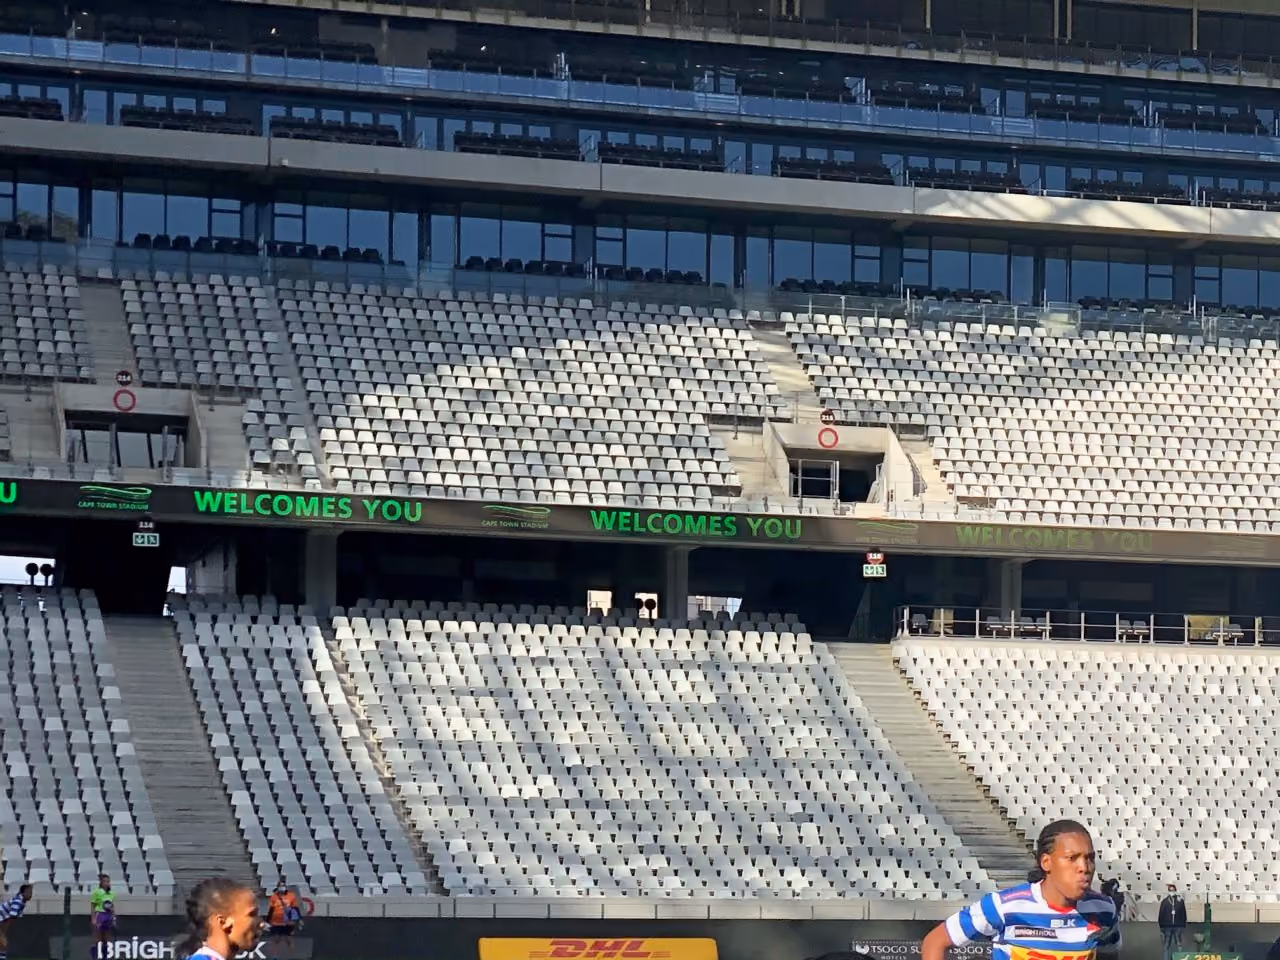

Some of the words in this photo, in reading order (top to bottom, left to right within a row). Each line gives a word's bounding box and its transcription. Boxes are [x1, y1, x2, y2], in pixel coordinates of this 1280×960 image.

[194, 490, 352, 519] WELCOMES
[362, 499, 422, 523] YOU
[589, 509, 737, 537] WELCOMES
[747, 517, 803, 539] YOU
[955, 525, 1095, 551] WELCOMES
[1102, 532, 1154, 553] YOU
[1050, 919, 1076, 928] BLK
[548, 940, 652, 958] DHL
[870, 945, 909, 954] TSOGO
